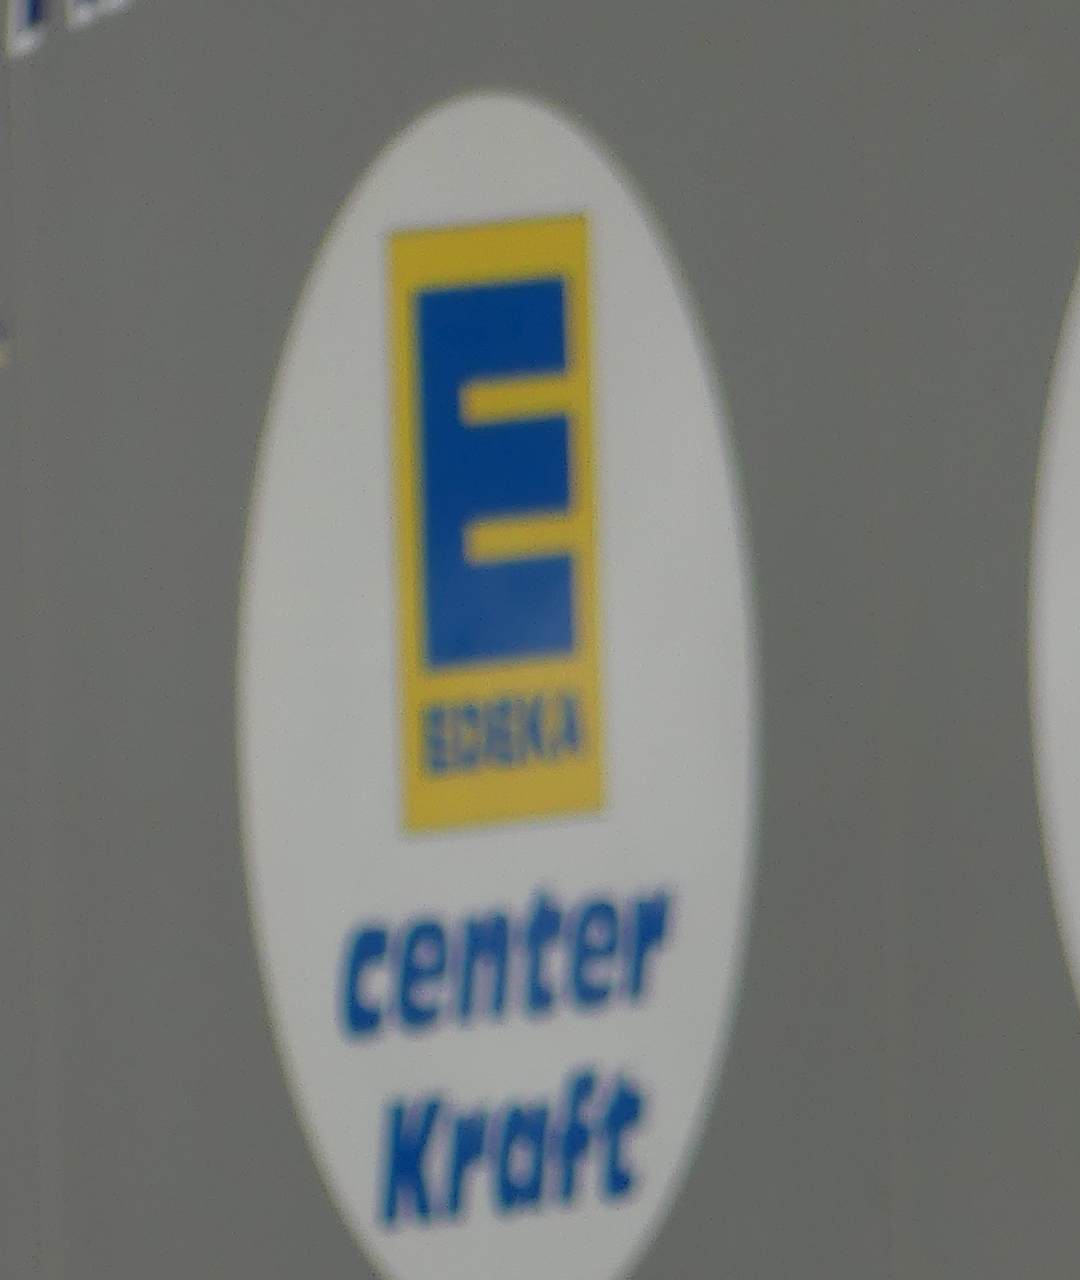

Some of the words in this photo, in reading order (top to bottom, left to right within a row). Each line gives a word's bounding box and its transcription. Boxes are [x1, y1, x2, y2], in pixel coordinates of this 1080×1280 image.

[416, 275, 575, 672] E
[420, 692, 586, 780] EDEKA
[338, 888, 674, 1042] center
[380, 1064, 646, 1230] Kraft
